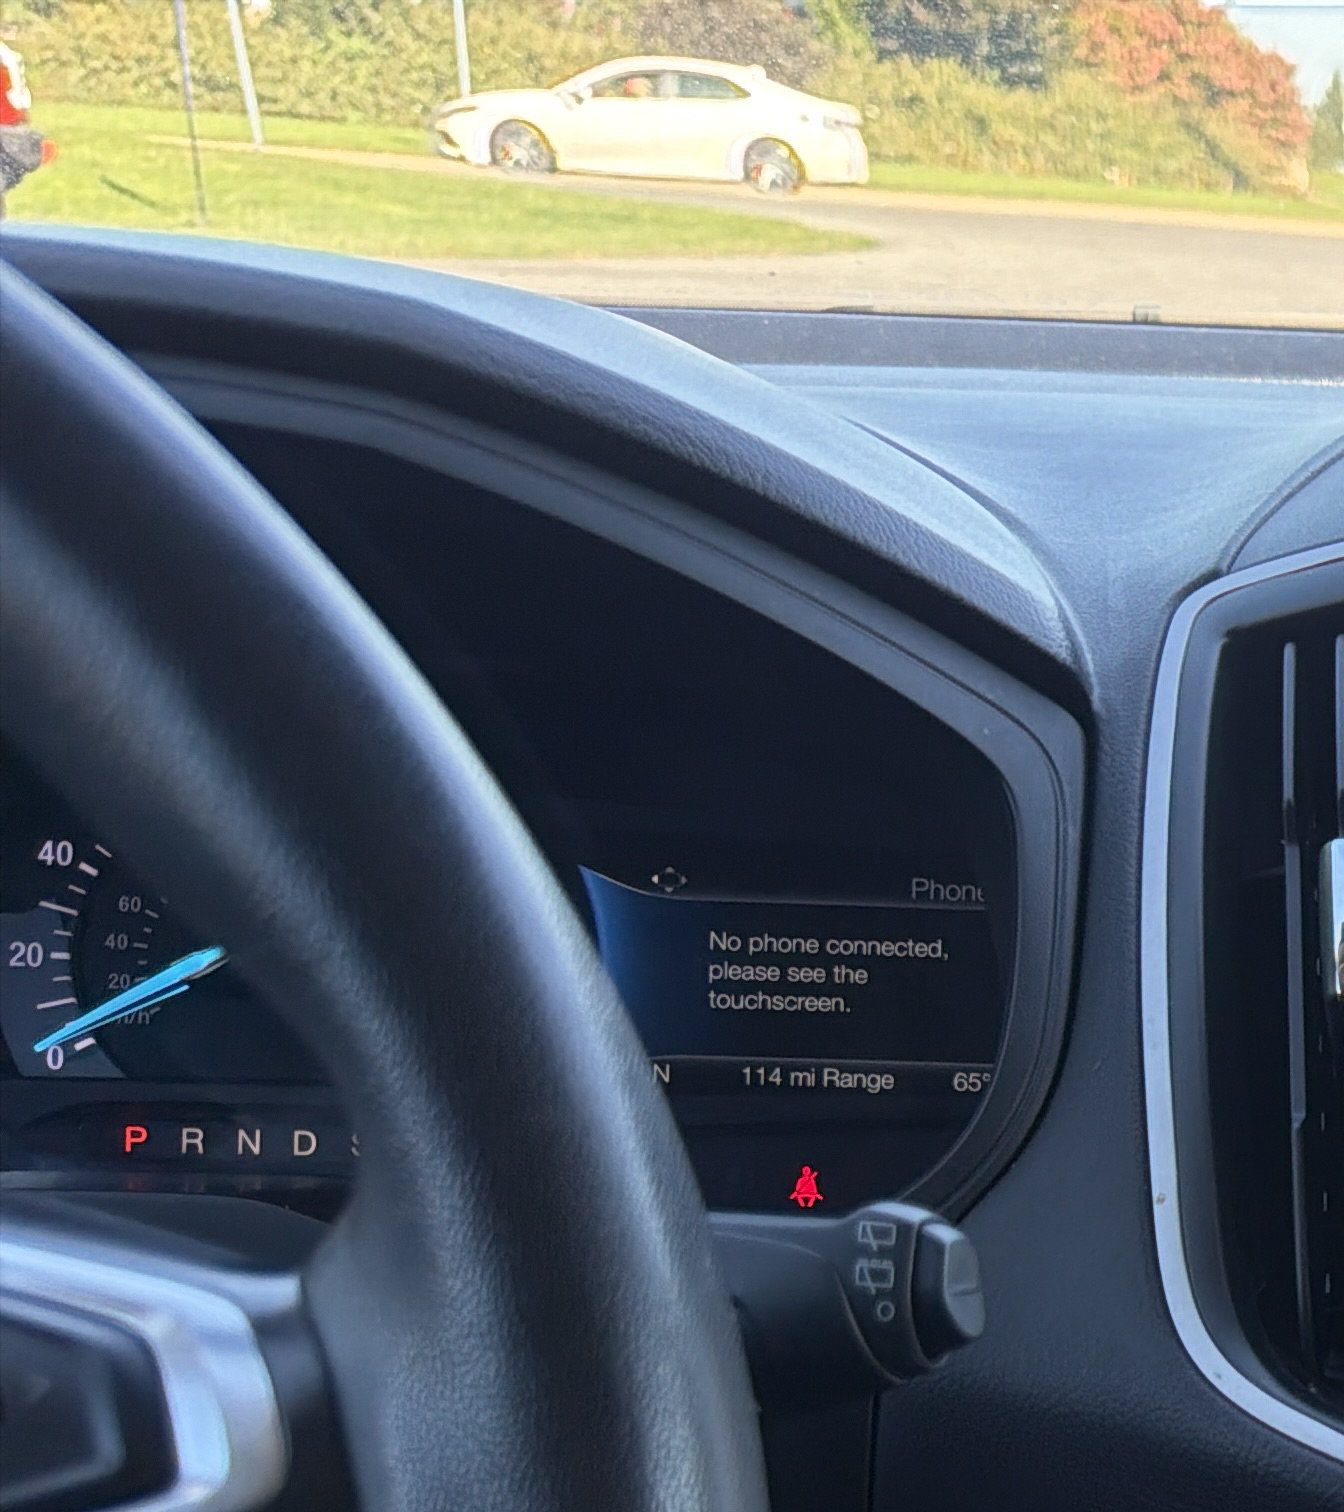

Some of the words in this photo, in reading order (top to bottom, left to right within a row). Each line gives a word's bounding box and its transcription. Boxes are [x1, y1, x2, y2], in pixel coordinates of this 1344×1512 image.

[38, 841, 74, 867] 40
[118, 897, 142, 914] 60
[9, 942, 44, 968] 20
[105, 934, 129, 951] 40
[708, 931, 742, 951] No
[748, 933, 820, 956] phone
[825, 938, 950, 961] connected,
[108, 973, 130, 990] 20
[708, 961, 781, 984] please
[786, 966, 827, 984] see
[833, 965, 869, 985] the
[708, 991, 851, 1013] touchscreen.
[45, 1046, 64, 1070] 0
[742, 1066, 782, 1087] 114
[789, 1068, 816, 1088] mi
[823, 1068, 895, 1094] Range
[123, 1126, 148, 1152] P
[181, 1127, 204, 1154] R
[237, 1129, 261, 1154] N
[293, 1130, 318, 1156] D
